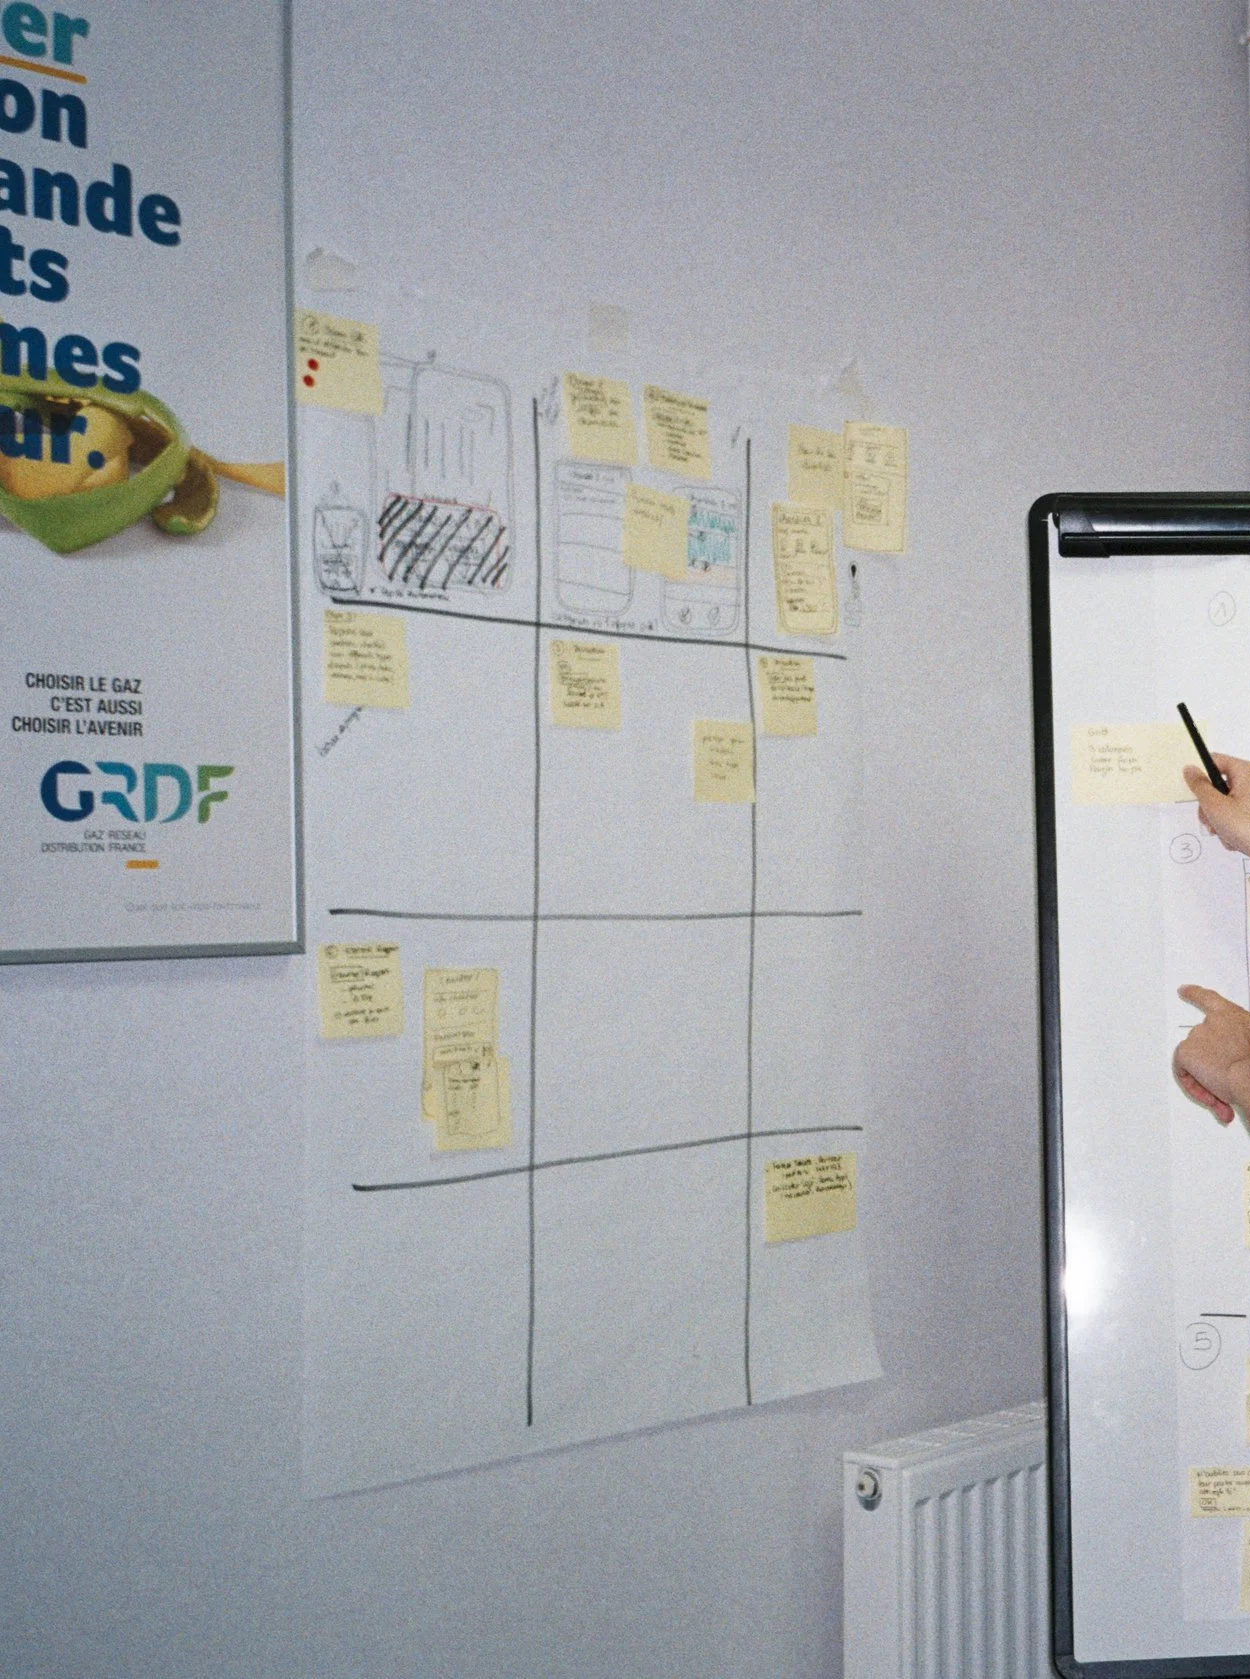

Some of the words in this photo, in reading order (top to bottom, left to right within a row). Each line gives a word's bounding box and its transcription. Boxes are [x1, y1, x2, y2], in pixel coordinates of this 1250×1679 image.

[1, 1, 90, 66] er
[0, 77, 88, 149] on
[0, 158, 182, 248] ande
[0, 224, 70, 303] ts
[0, 404, 106, 470] ur.
[25, 672, 86, 692] CHOISIR
[89, 676, 108, 693] LE
[112, 677, 143, 695] GAZ
[50, 695, 93, 714] C'EST
[97, 699, 143, 716] AUSSI
[11, 715, 72, 735] CHOISIR
[76, 719, 144, 737] L'AVENIR
[40, 760, 235, 825] GRDF
[41, 841, 106, 854] DISTRIBUTION
[108, 842, 146, 853] FRANCE
[83, 829, 106, 841] GAZ
